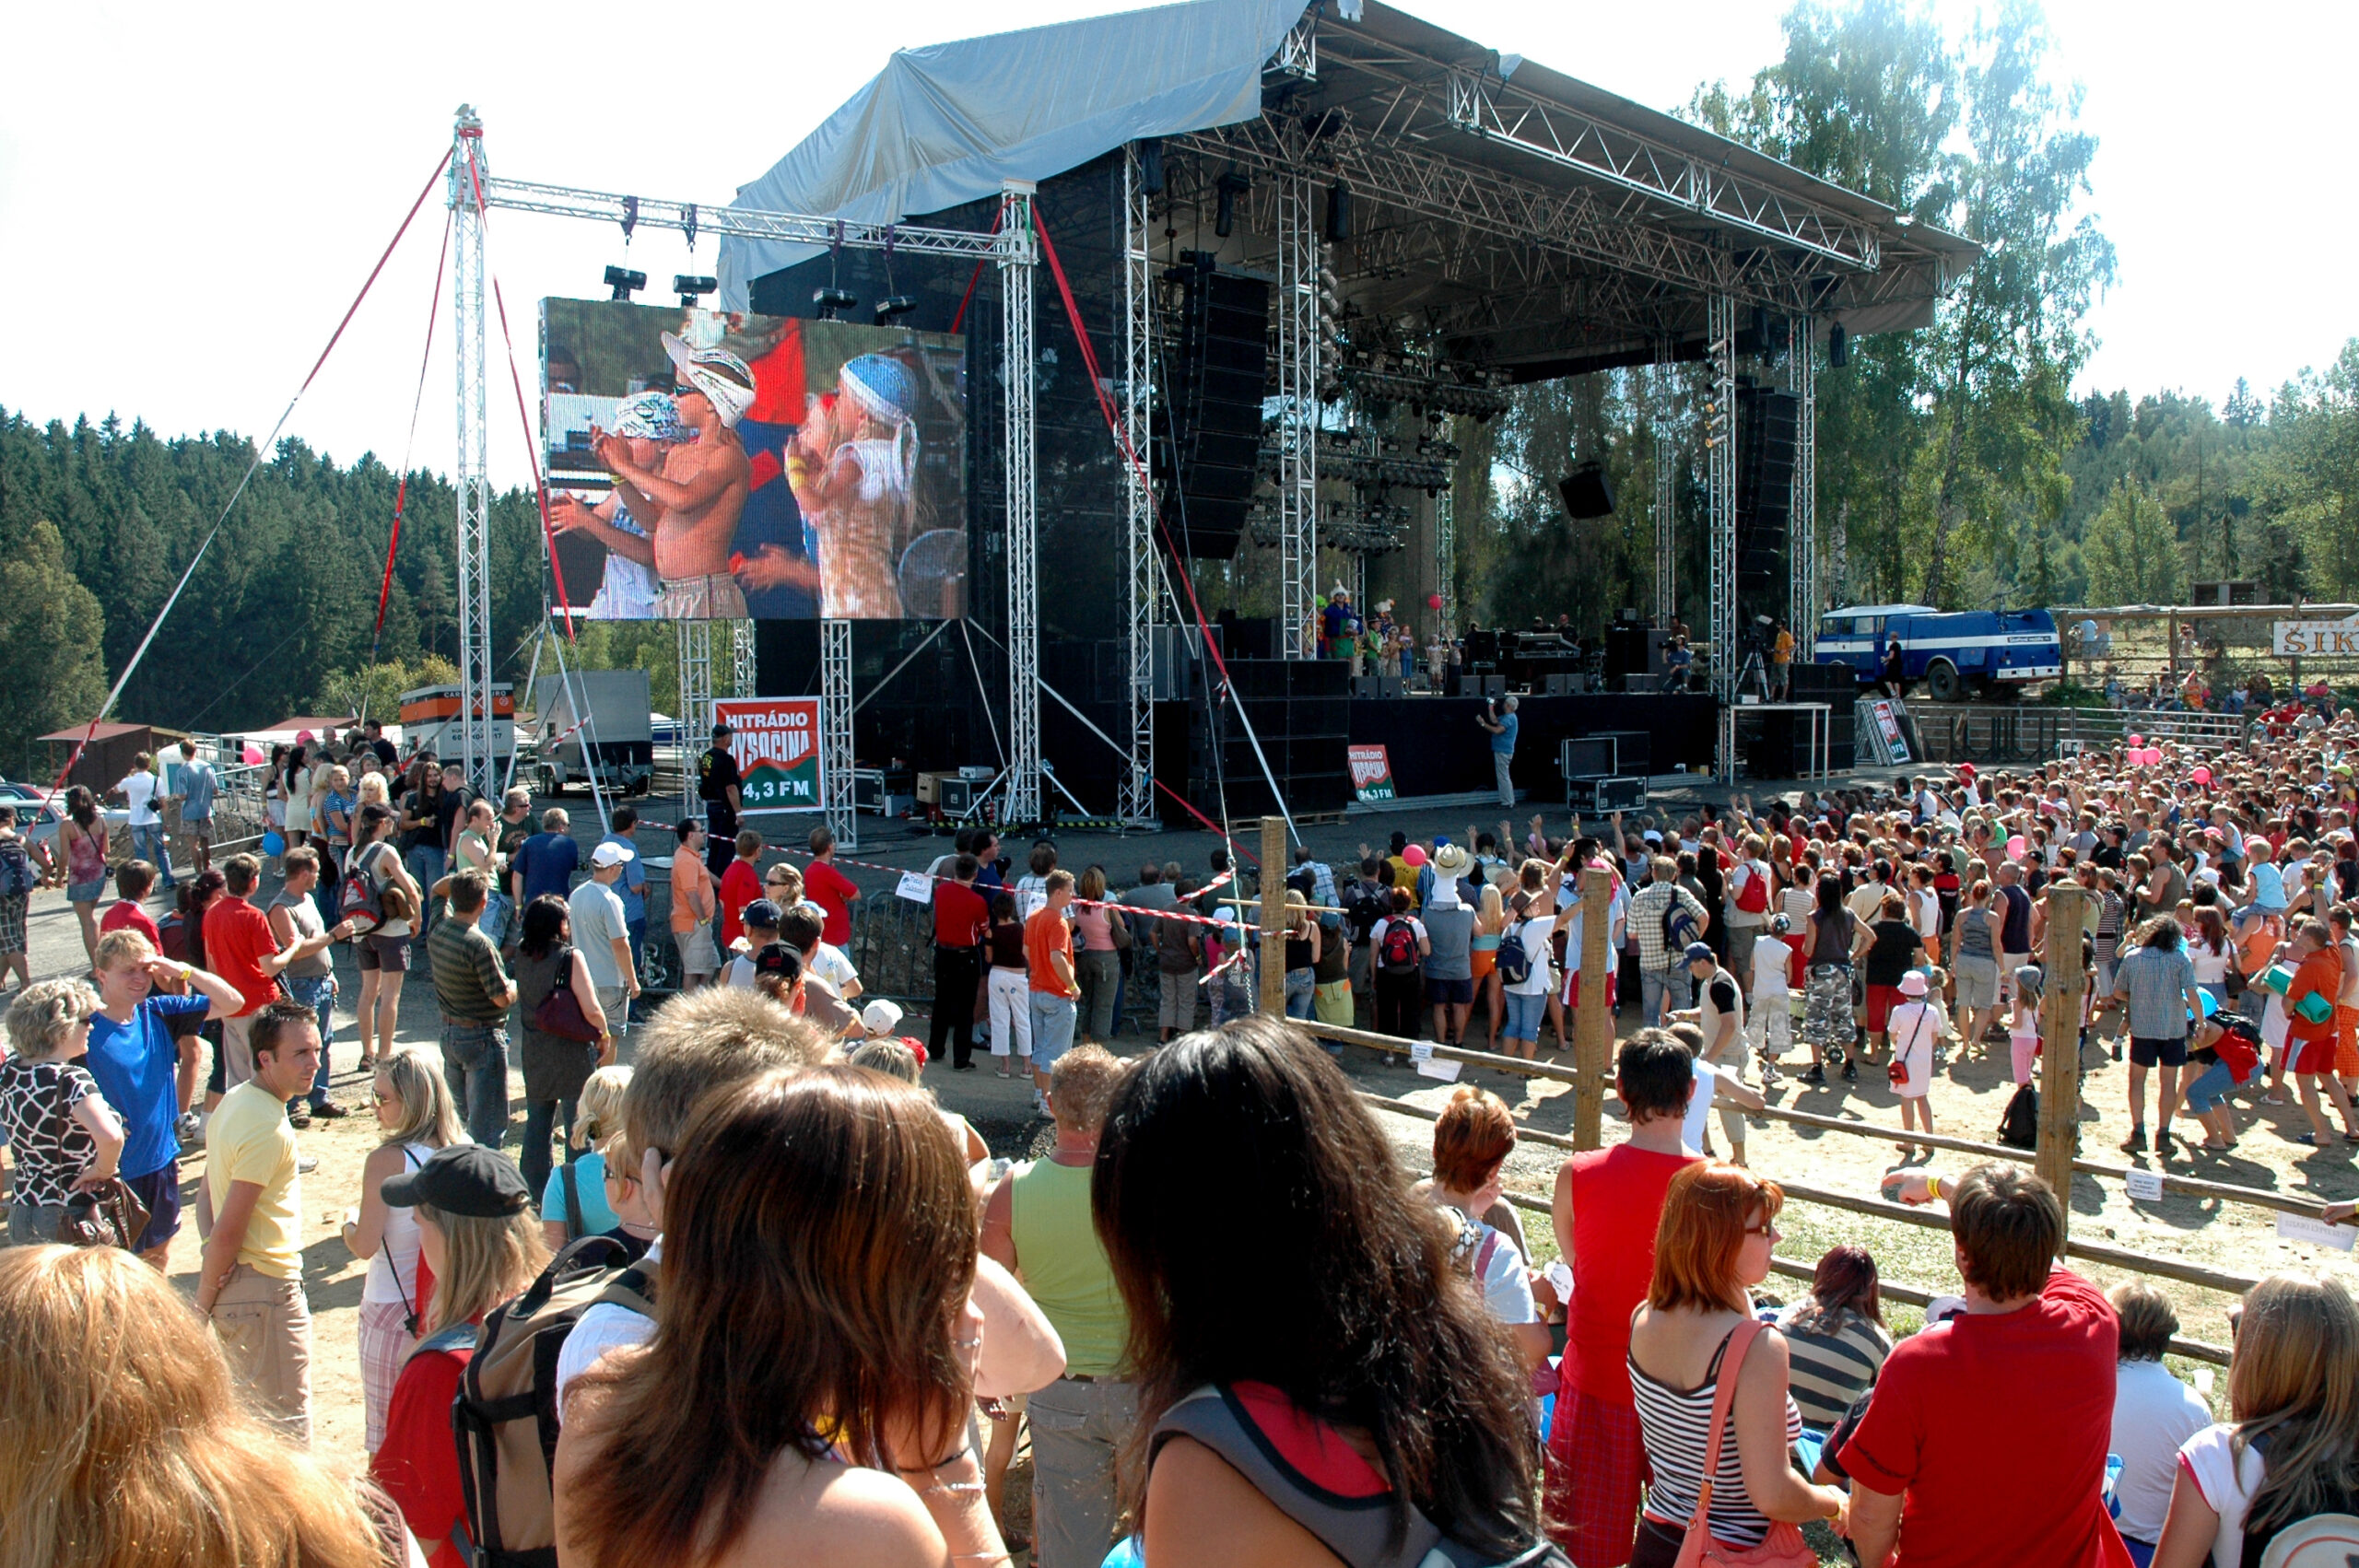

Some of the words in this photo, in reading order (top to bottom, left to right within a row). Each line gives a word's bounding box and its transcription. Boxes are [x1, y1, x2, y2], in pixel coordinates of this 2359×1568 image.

[725, 709, 808, 728] HITRÁDIO
[1348, 749, 1383, 760] HITRÁDIO
[743, 782, 774, 801] 4,3
[779, 780, 809, 796] FM
[1379, 788, 1393, 799] FM
